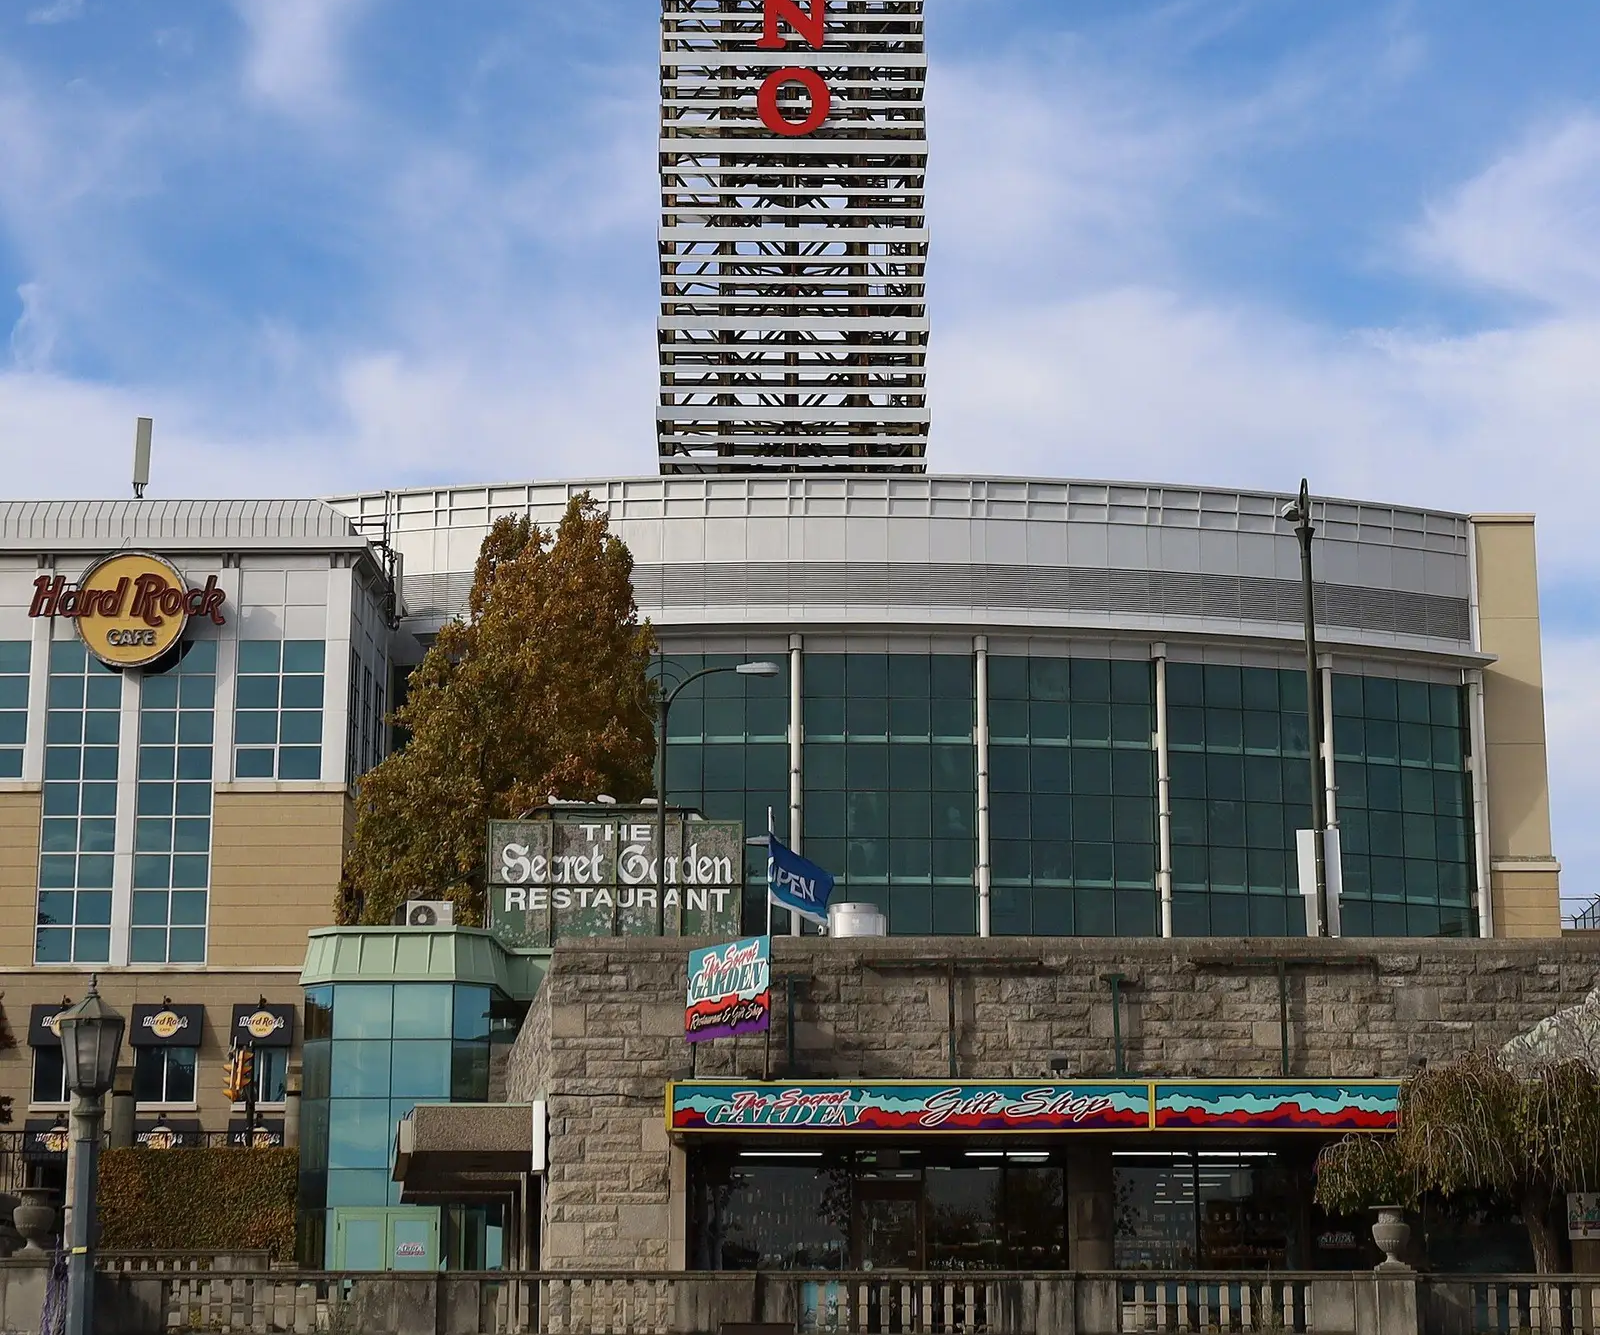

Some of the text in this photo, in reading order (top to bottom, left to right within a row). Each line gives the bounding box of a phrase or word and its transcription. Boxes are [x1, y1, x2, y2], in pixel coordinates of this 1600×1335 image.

[28, 573, 226, 626] Hard Rock
[106, 628, 156, 646] CAFE
[579, 824, 652, 842] THE
[501, 842, 734, 885] Secret Garden
[504, 887, 731, 913] RESTAURANT
[690, 959, 766, 1001] GARDEN
[142, 1016, 188, 1028] Hard Rock
[239, 1016, 285, 1028] Hard Rock
[732, 1088, 852, 1111] The Secret
[919, 1087, 1112, 1126] Gift Shop
[705, 1104, 868, 1126] GARDEN
